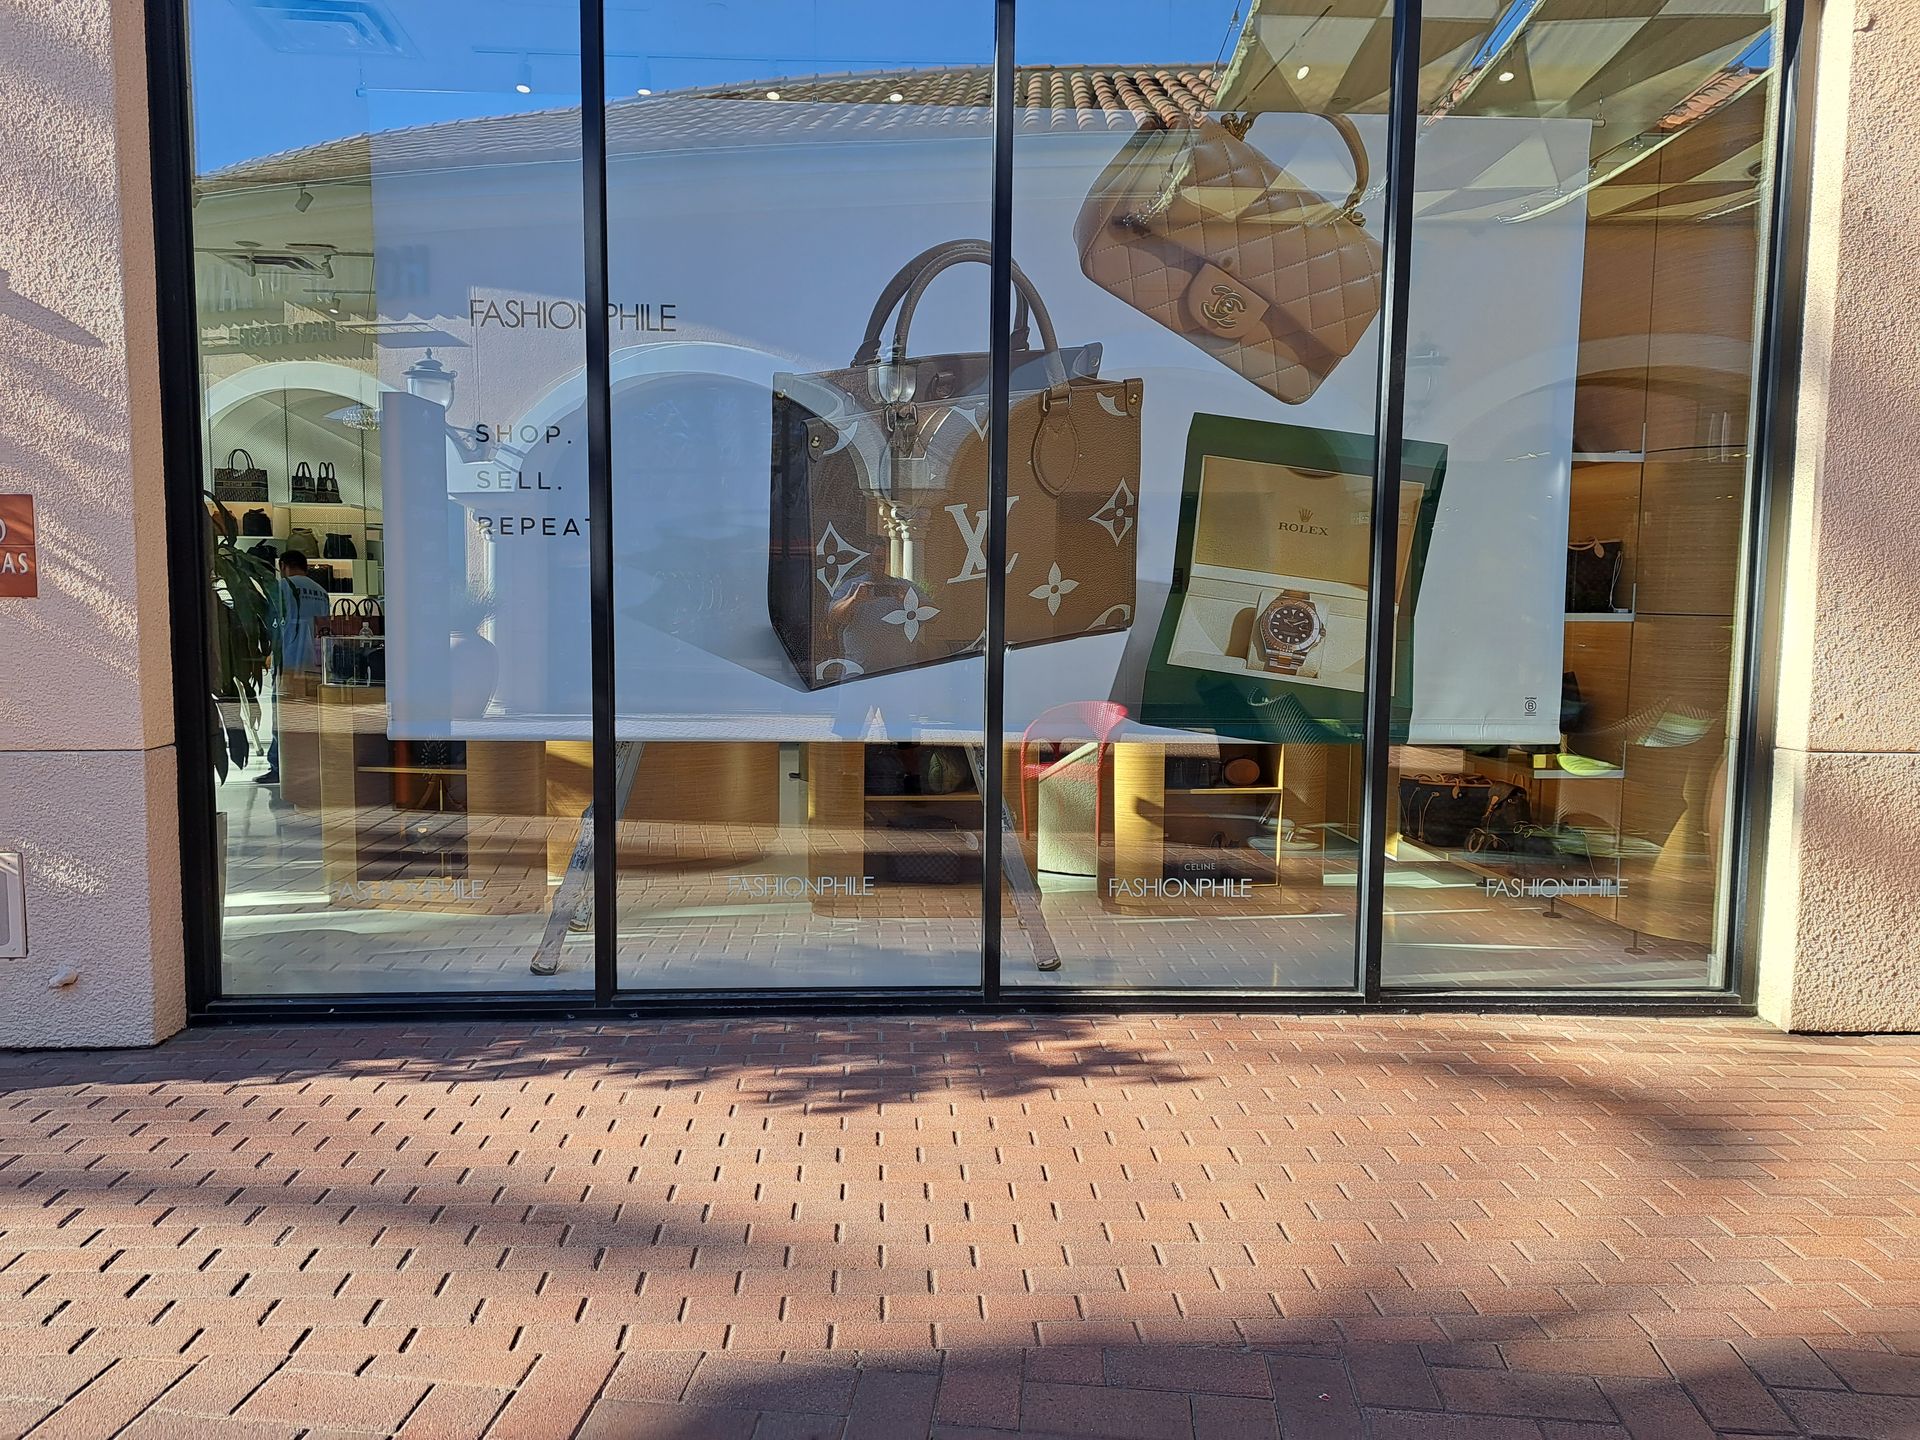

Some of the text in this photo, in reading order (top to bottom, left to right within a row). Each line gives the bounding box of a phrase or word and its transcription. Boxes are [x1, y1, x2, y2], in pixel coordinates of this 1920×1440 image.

[475, 423, 572, 444] SHOP.
[476, 470, 562, 490] SELL.
[1278, 521, 1328, 536] ROLEX
[1184, 863, 1216, 871] CELINE
[728, 876, 875, 897] FASHIONPHILE
[1108, 877, 1253, 898] FASHIONPHILE
[1485, 878, 1629, 898] FASHIONPHILE
